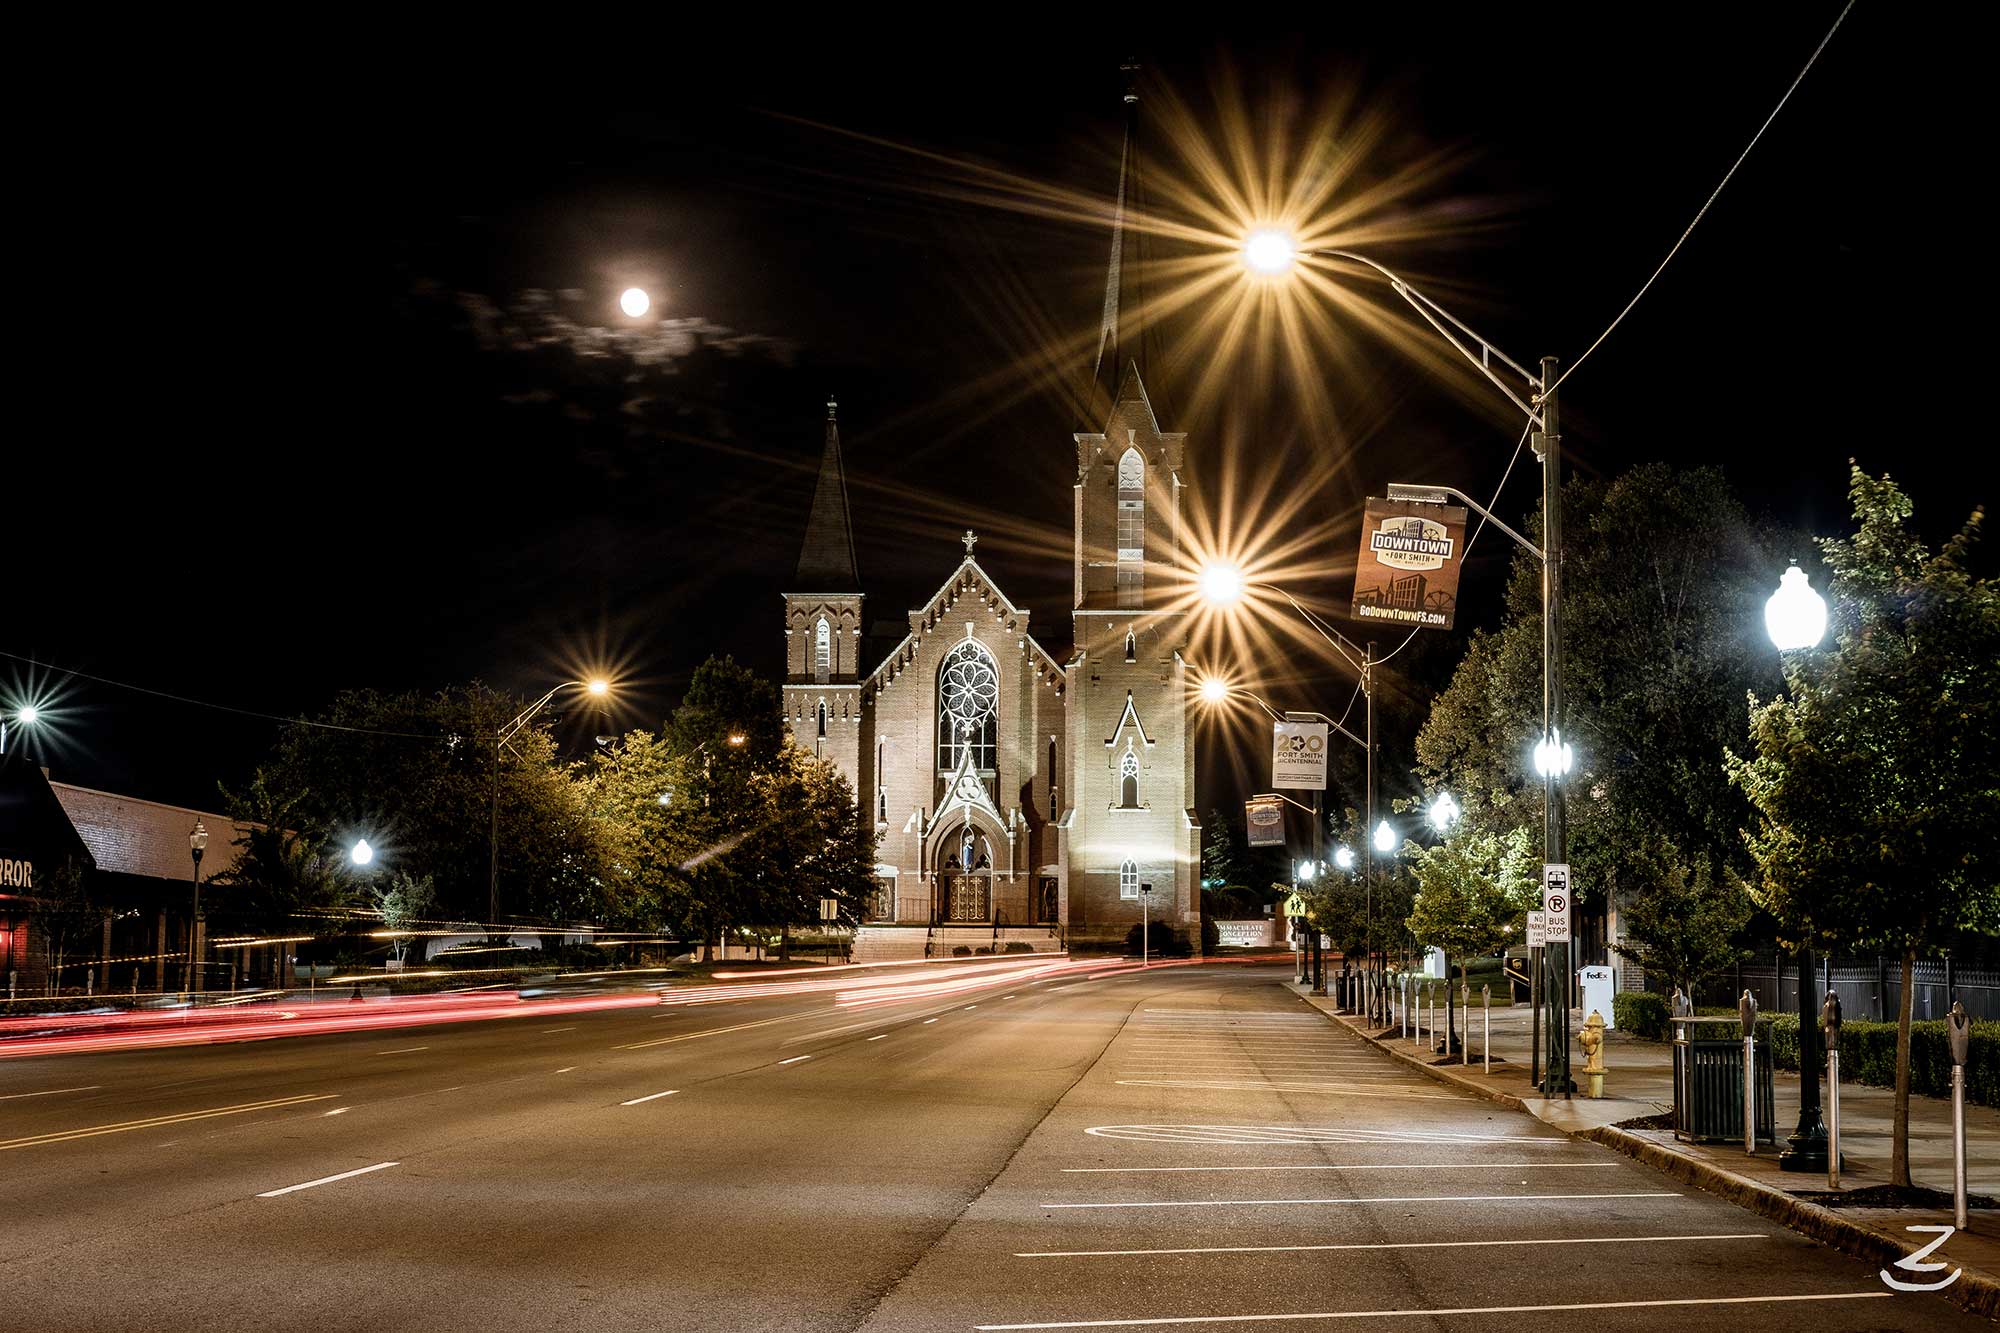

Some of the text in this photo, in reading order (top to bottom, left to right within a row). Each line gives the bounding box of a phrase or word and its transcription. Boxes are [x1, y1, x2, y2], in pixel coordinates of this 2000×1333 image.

[1375, 535, 1449, 554] DOWNTOWN
[1390, 552, 1431, 562] FORT SMITH
[1548, 917, 1565, 926] BUS
[1547, 927, 1568, 935] STOP
